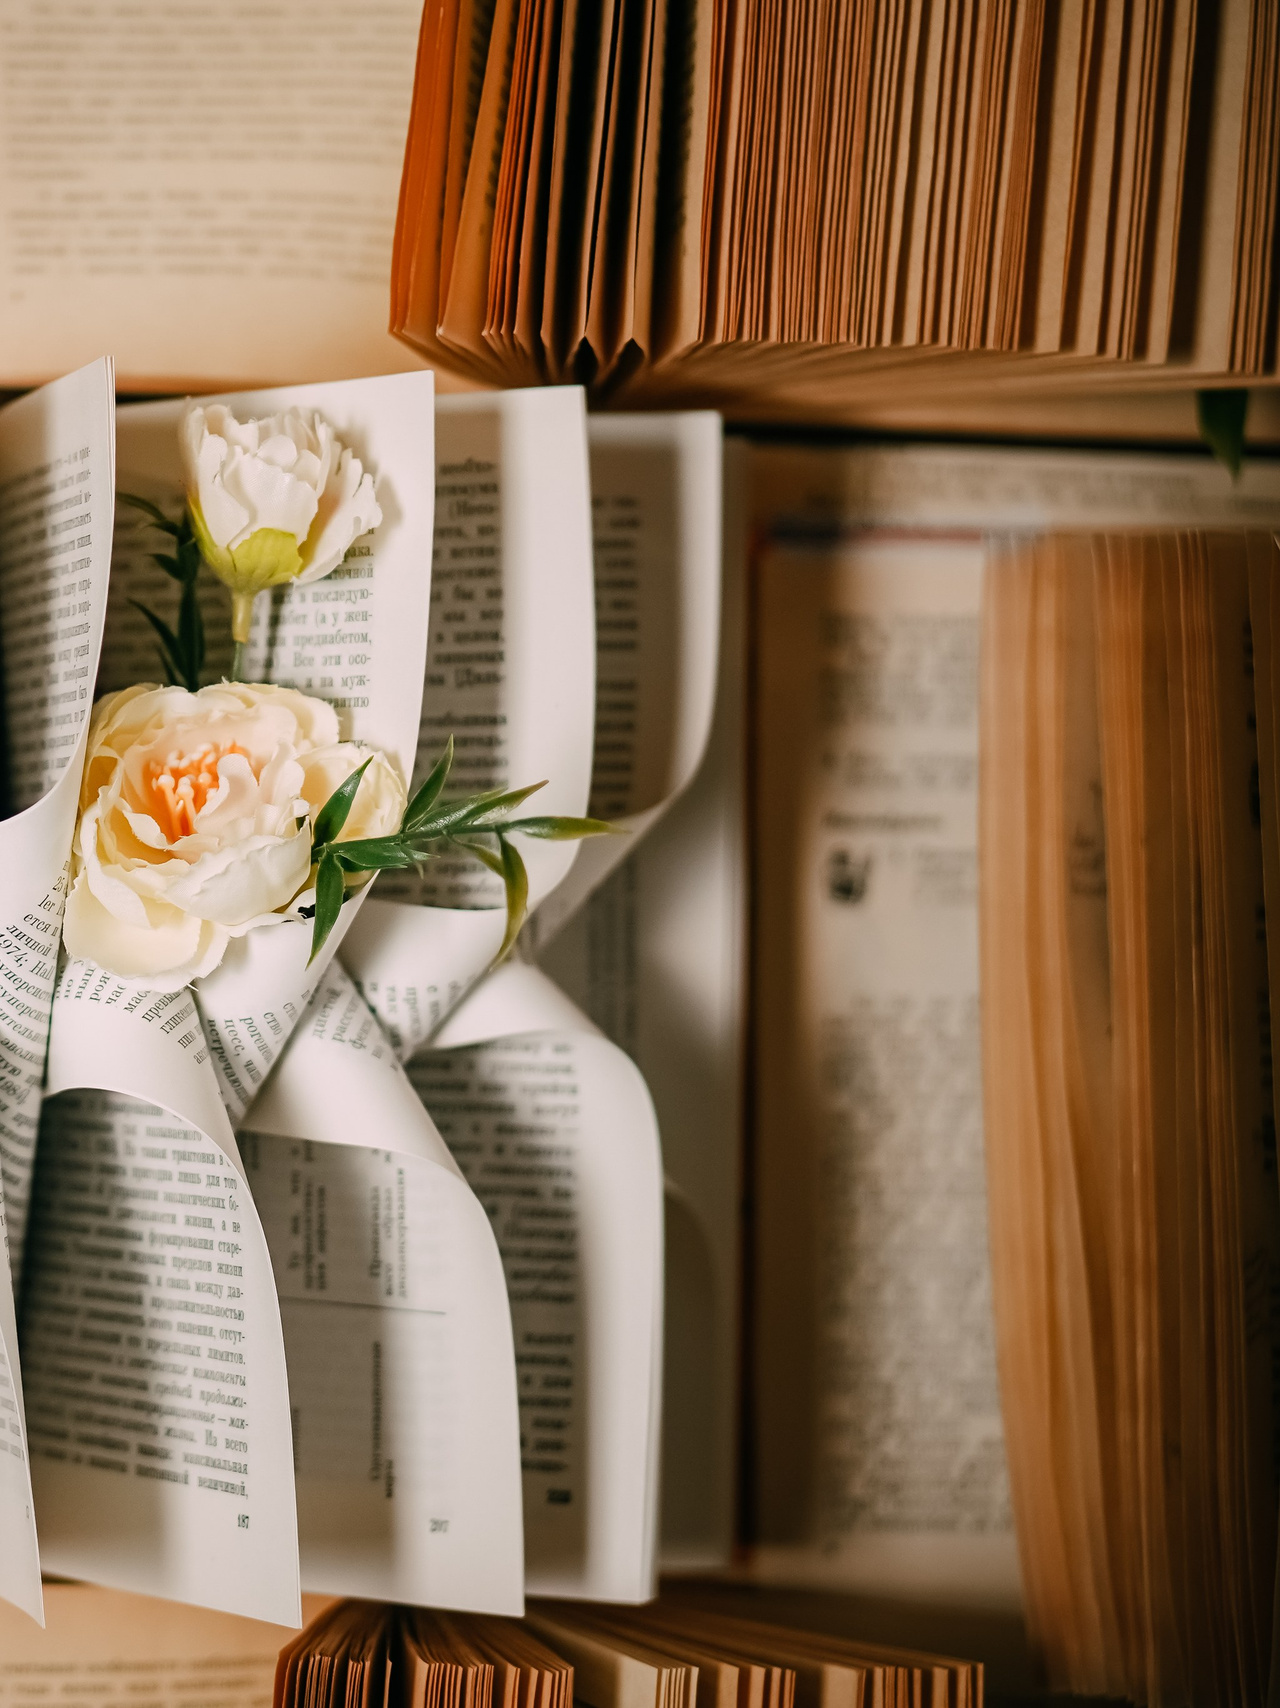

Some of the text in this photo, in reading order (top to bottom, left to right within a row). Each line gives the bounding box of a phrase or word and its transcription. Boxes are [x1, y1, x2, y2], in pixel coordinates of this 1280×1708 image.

[294, 653, 315, 667] Все
[348, 653, 371, 665] осо-
[23, 912, 51, 933] ется
[218, 1240, 242, 1257] старе-
[217, 1263, 243, 1277] жизни
[237, 1513, 250, 1529] 187
